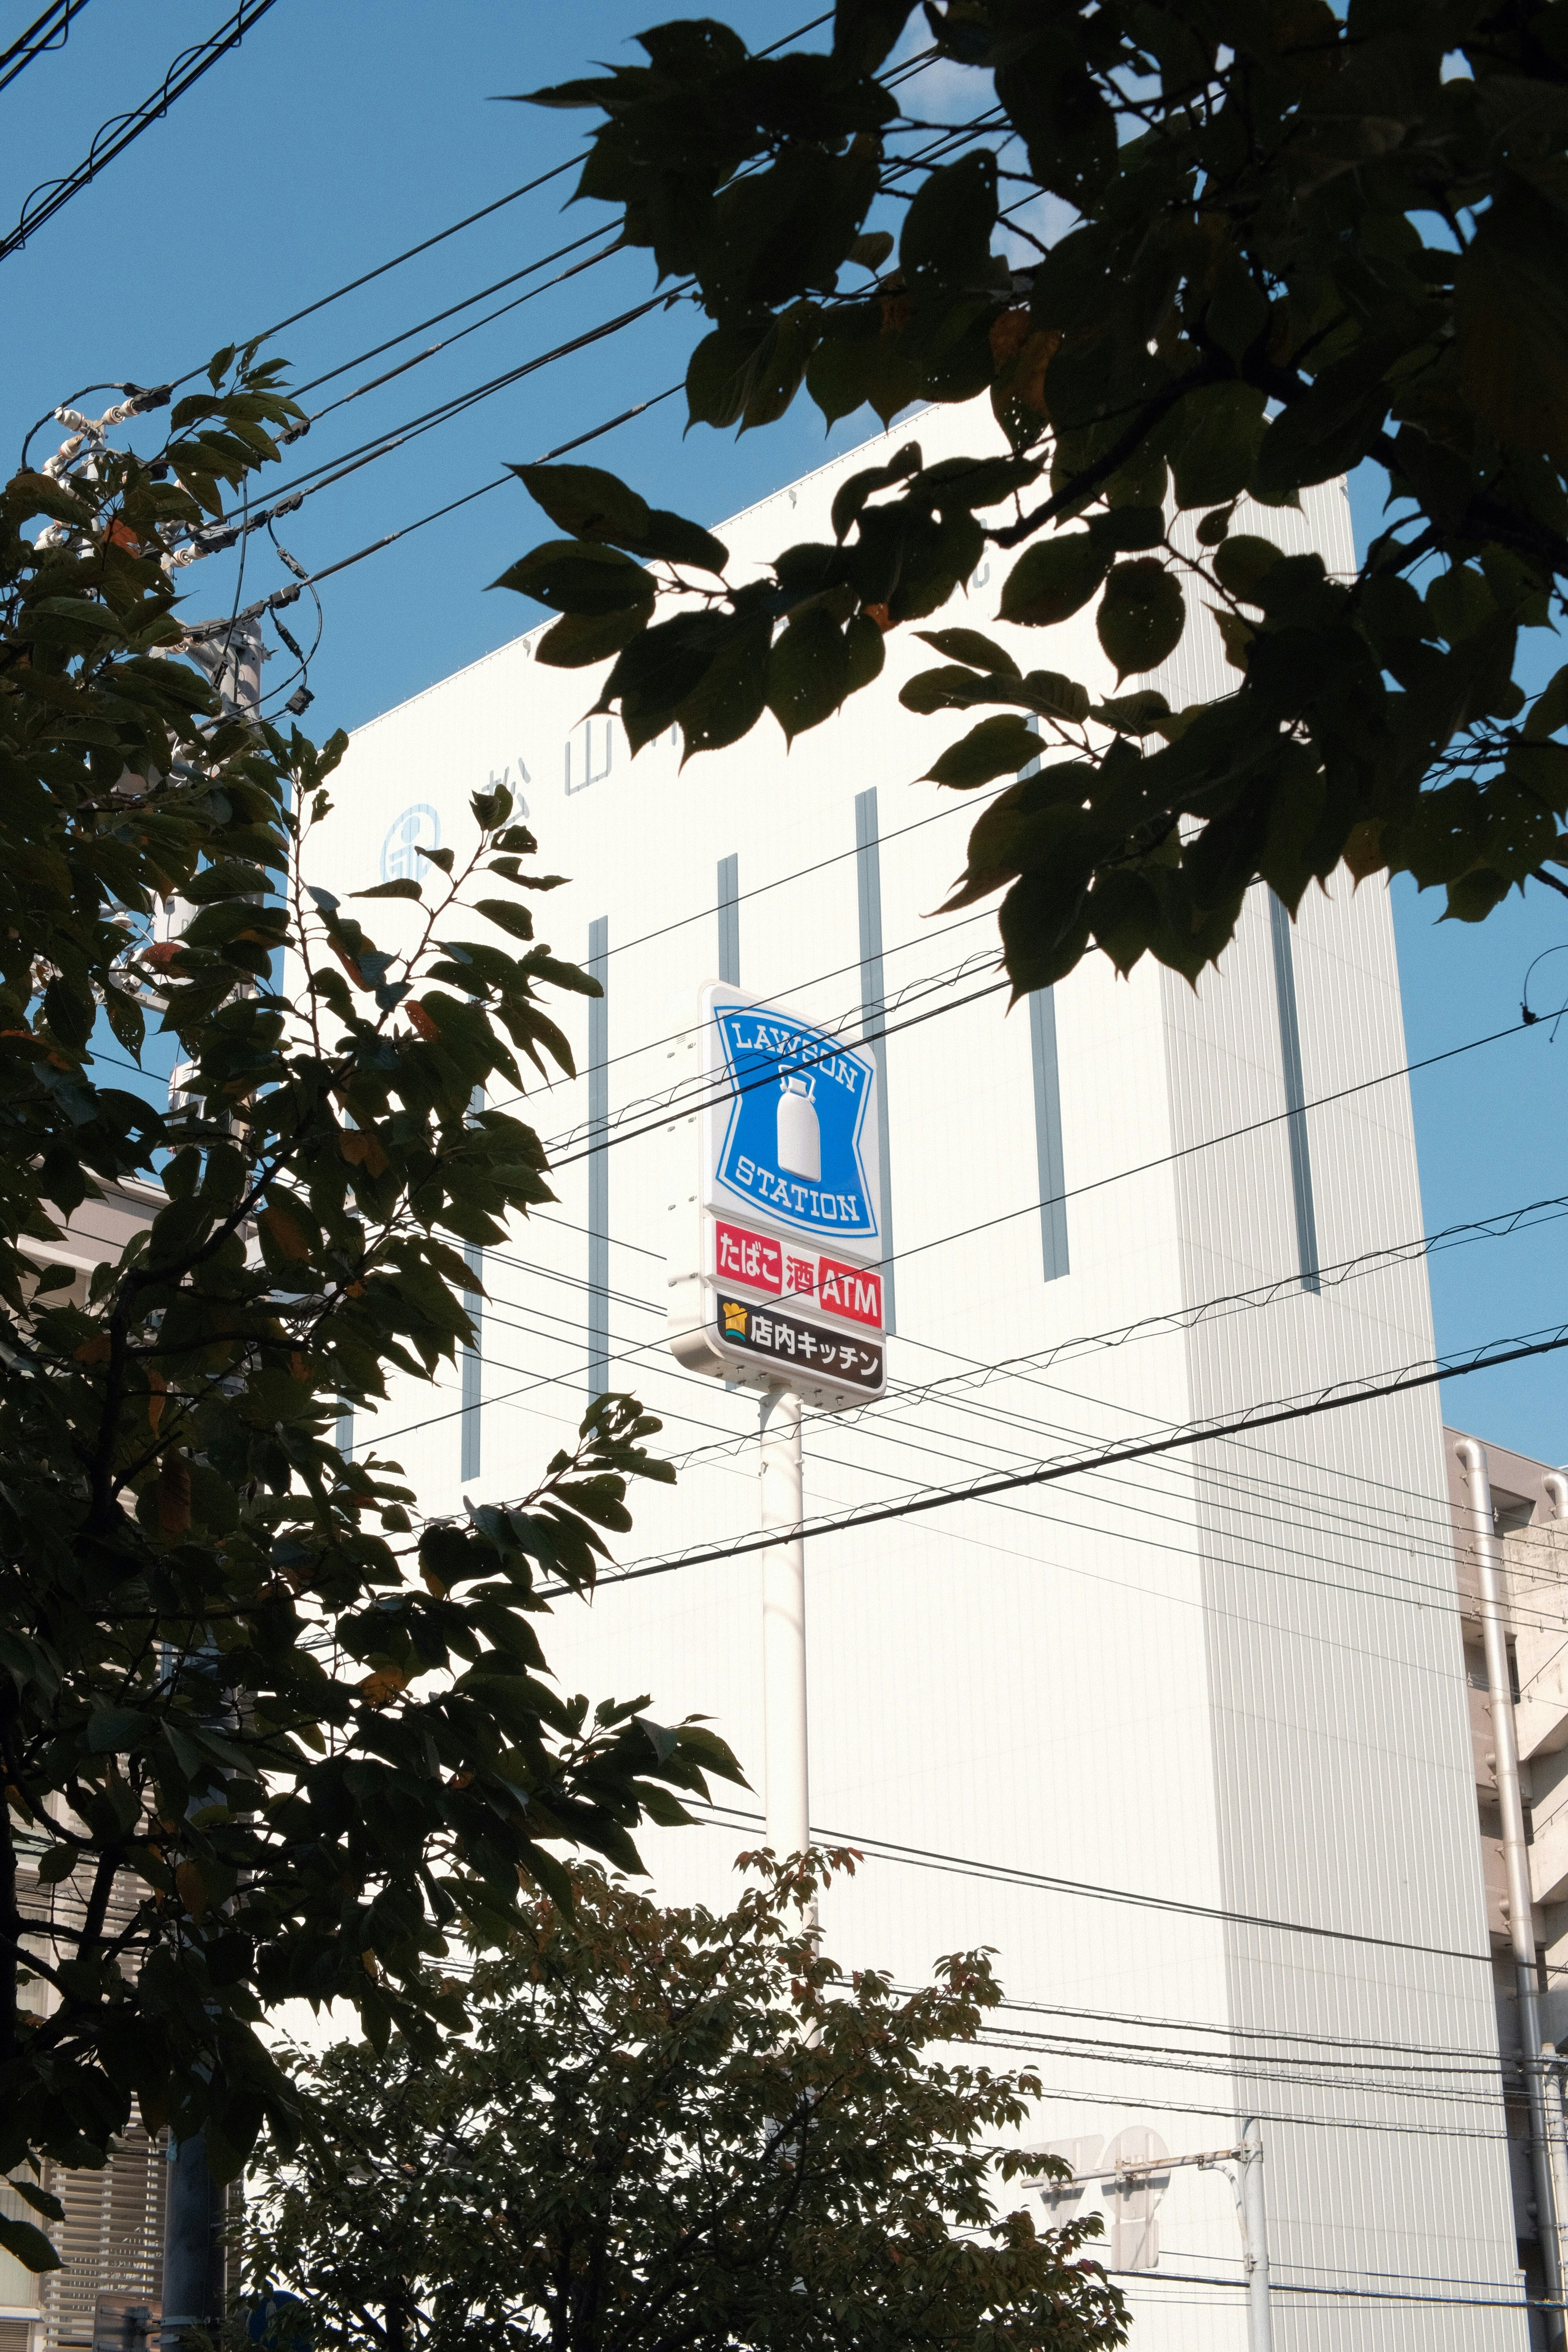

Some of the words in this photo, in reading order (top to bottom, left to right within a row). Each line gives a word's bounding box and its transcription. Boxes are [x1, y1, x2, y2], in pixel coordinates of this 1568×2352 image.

[731, 1022, 858, 1093] LAWSON
[736, 1155, 860, 1221] STATION
[720, 1232, 780, 1284] たばこ
[786, 1255, 814, 1297] 酒
[822, 1269, 878, 1317] ATM
[750, 1315, 879, 1376] 店内キッチン
